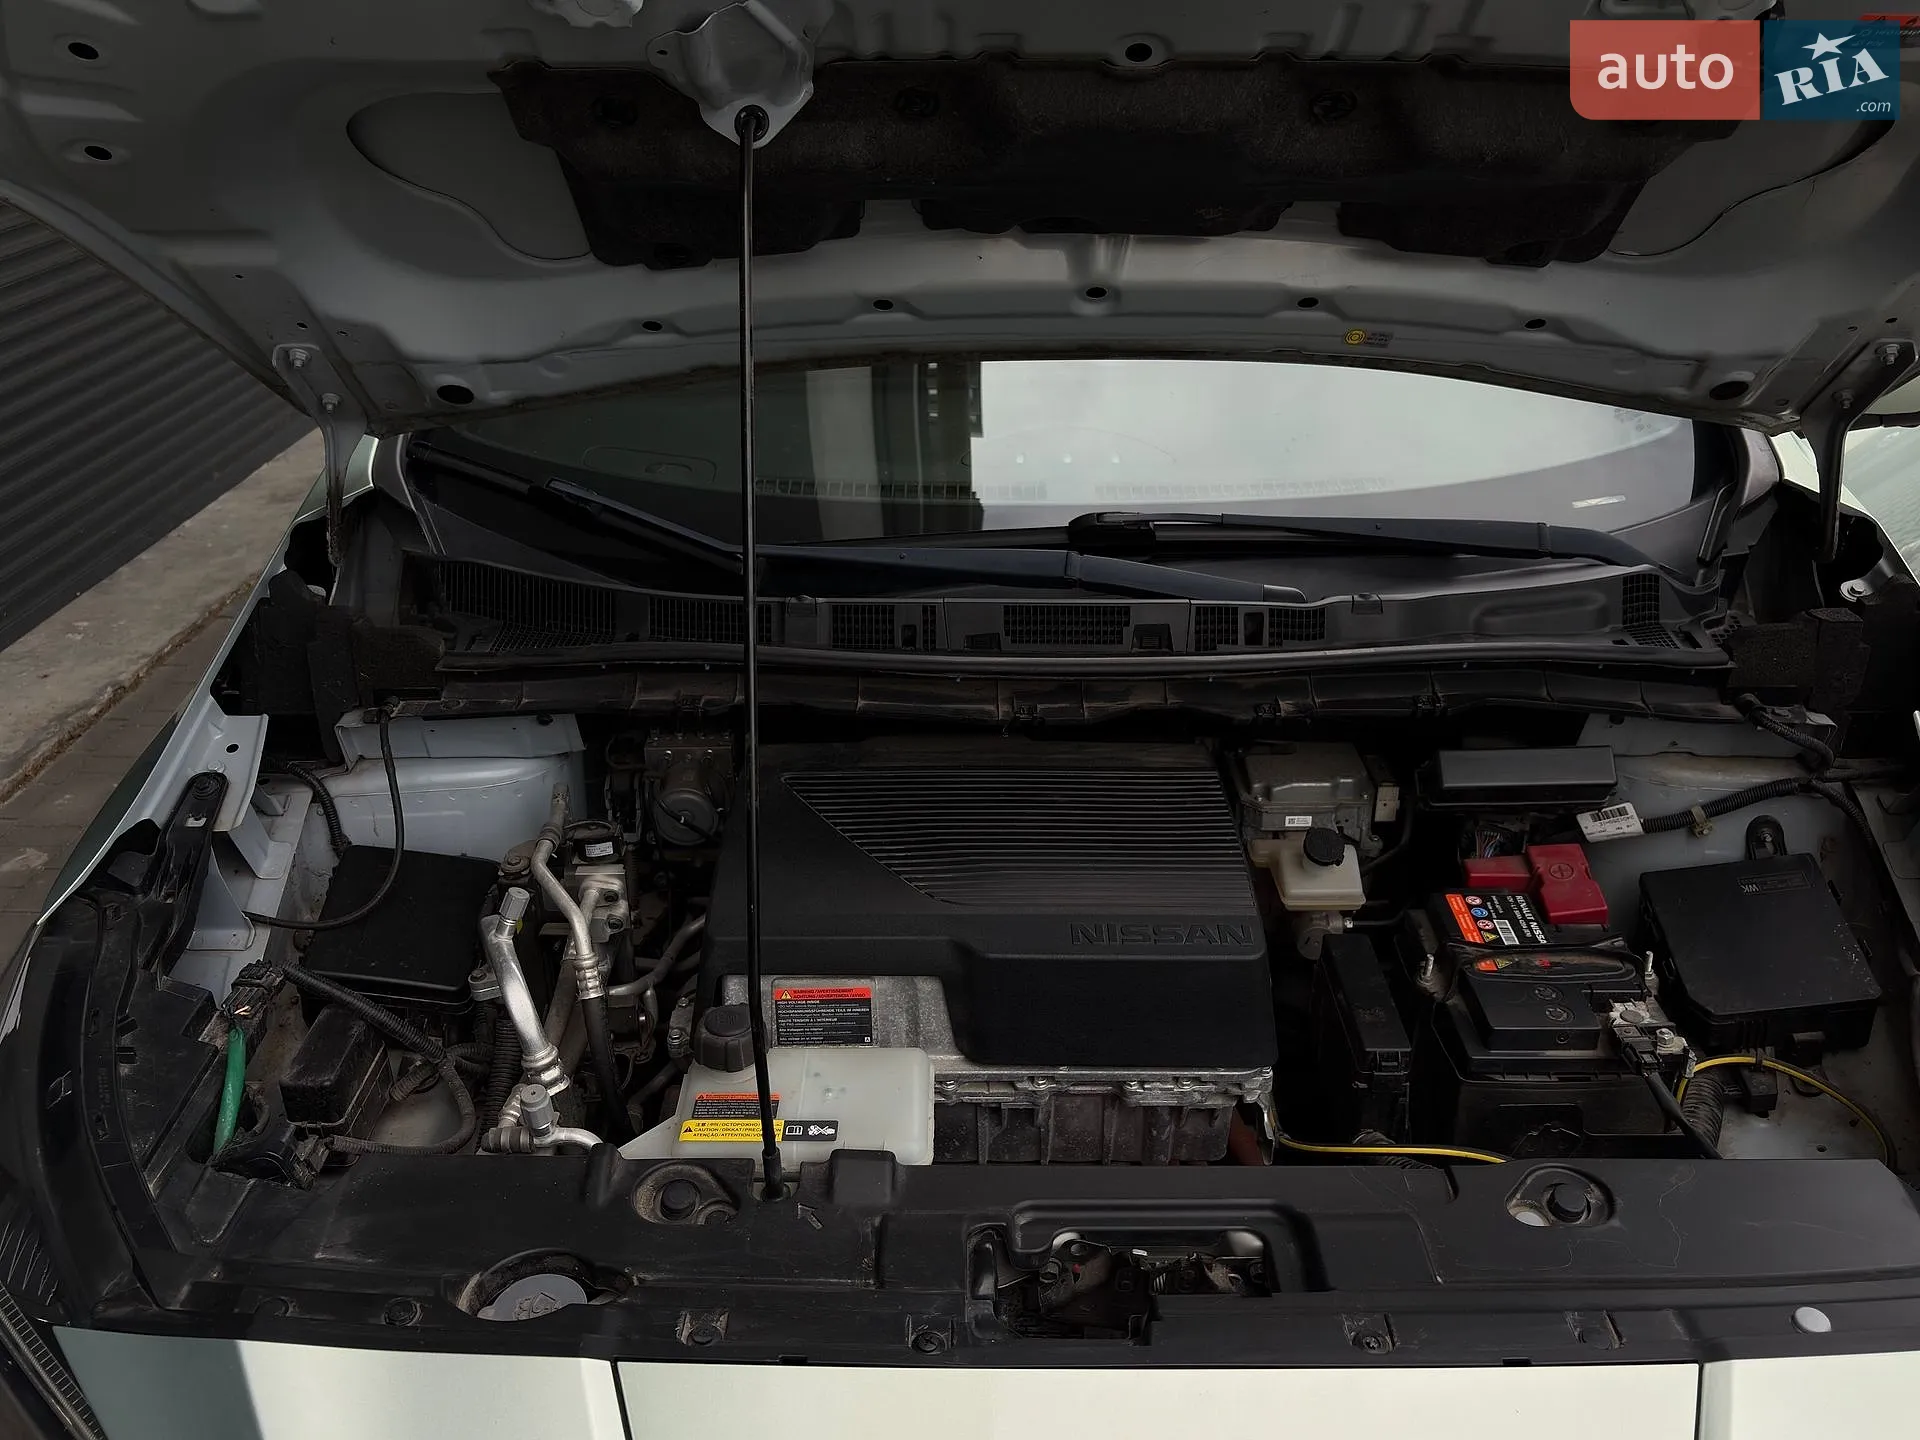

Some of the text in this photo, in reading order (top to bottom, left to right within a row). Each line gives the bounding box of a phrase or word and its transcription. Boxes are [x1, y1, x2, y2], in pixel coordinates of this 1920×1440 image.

[1069, 922, 1255, 946] NISSAN
[1515, 895, 1548, 944] RENAULT NISSA
